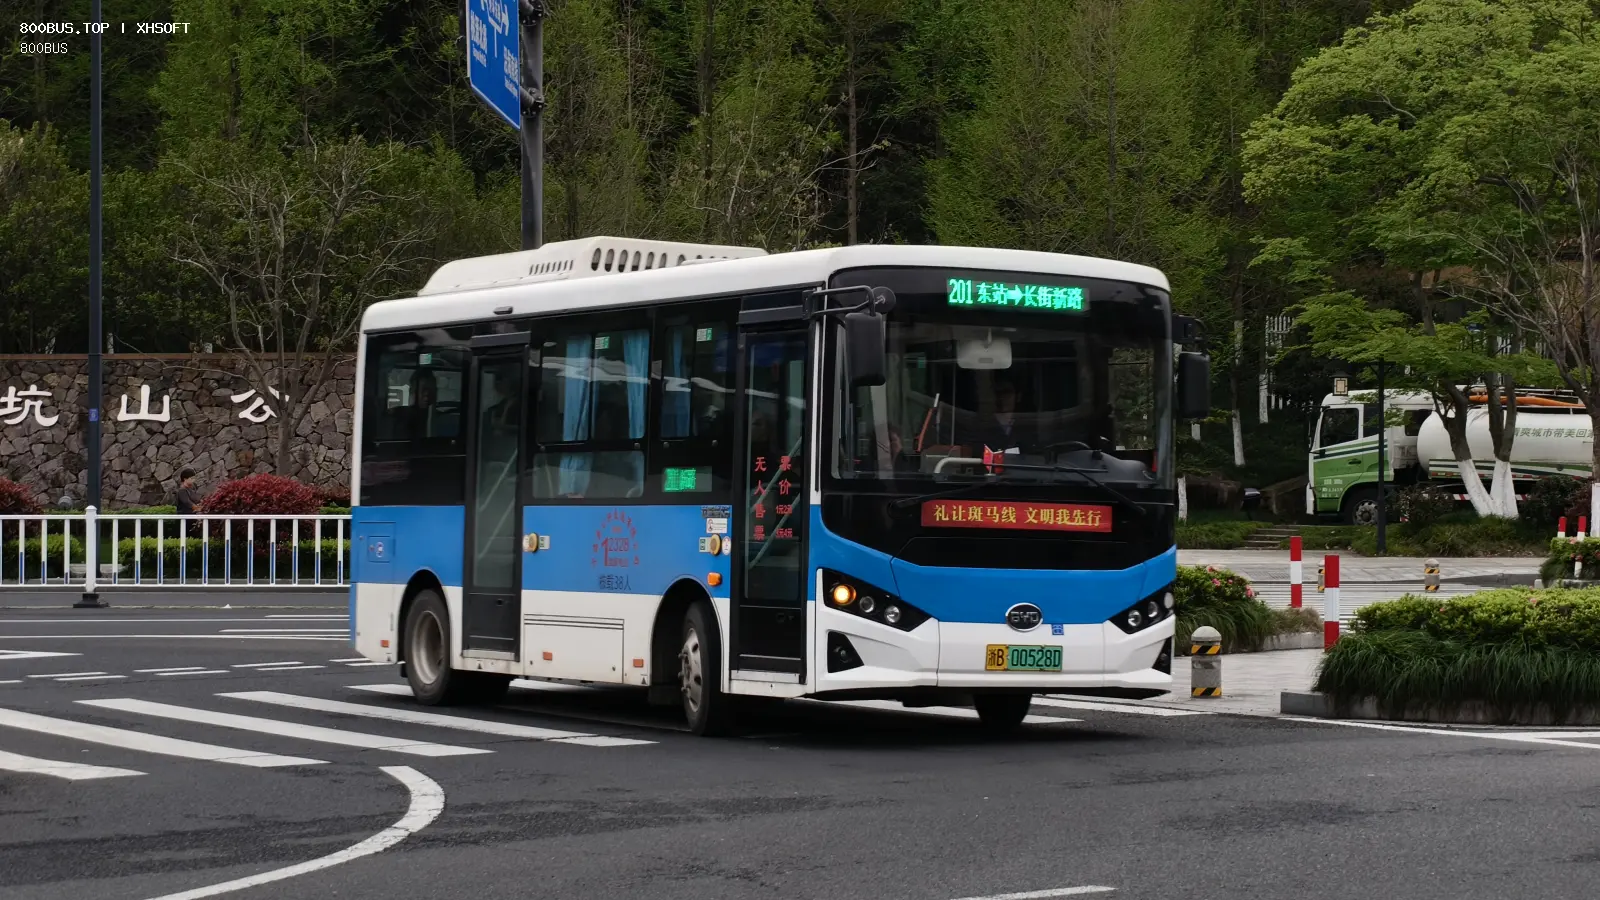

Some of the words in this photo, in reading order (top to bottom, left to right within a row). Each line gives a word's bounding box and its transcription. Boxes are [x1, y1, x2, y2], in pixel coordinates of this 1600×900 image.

[948, 279, 973, 304] 201
[976, 281, 1008, 305] 东站
[1023, 284, 1083, 310] 长街新路
[933, 504, 1017, 524] 礼让斑马线
[1023, 506, 1102, 527] 文明我先行
[1010, 611, 1040, 622] BYD
